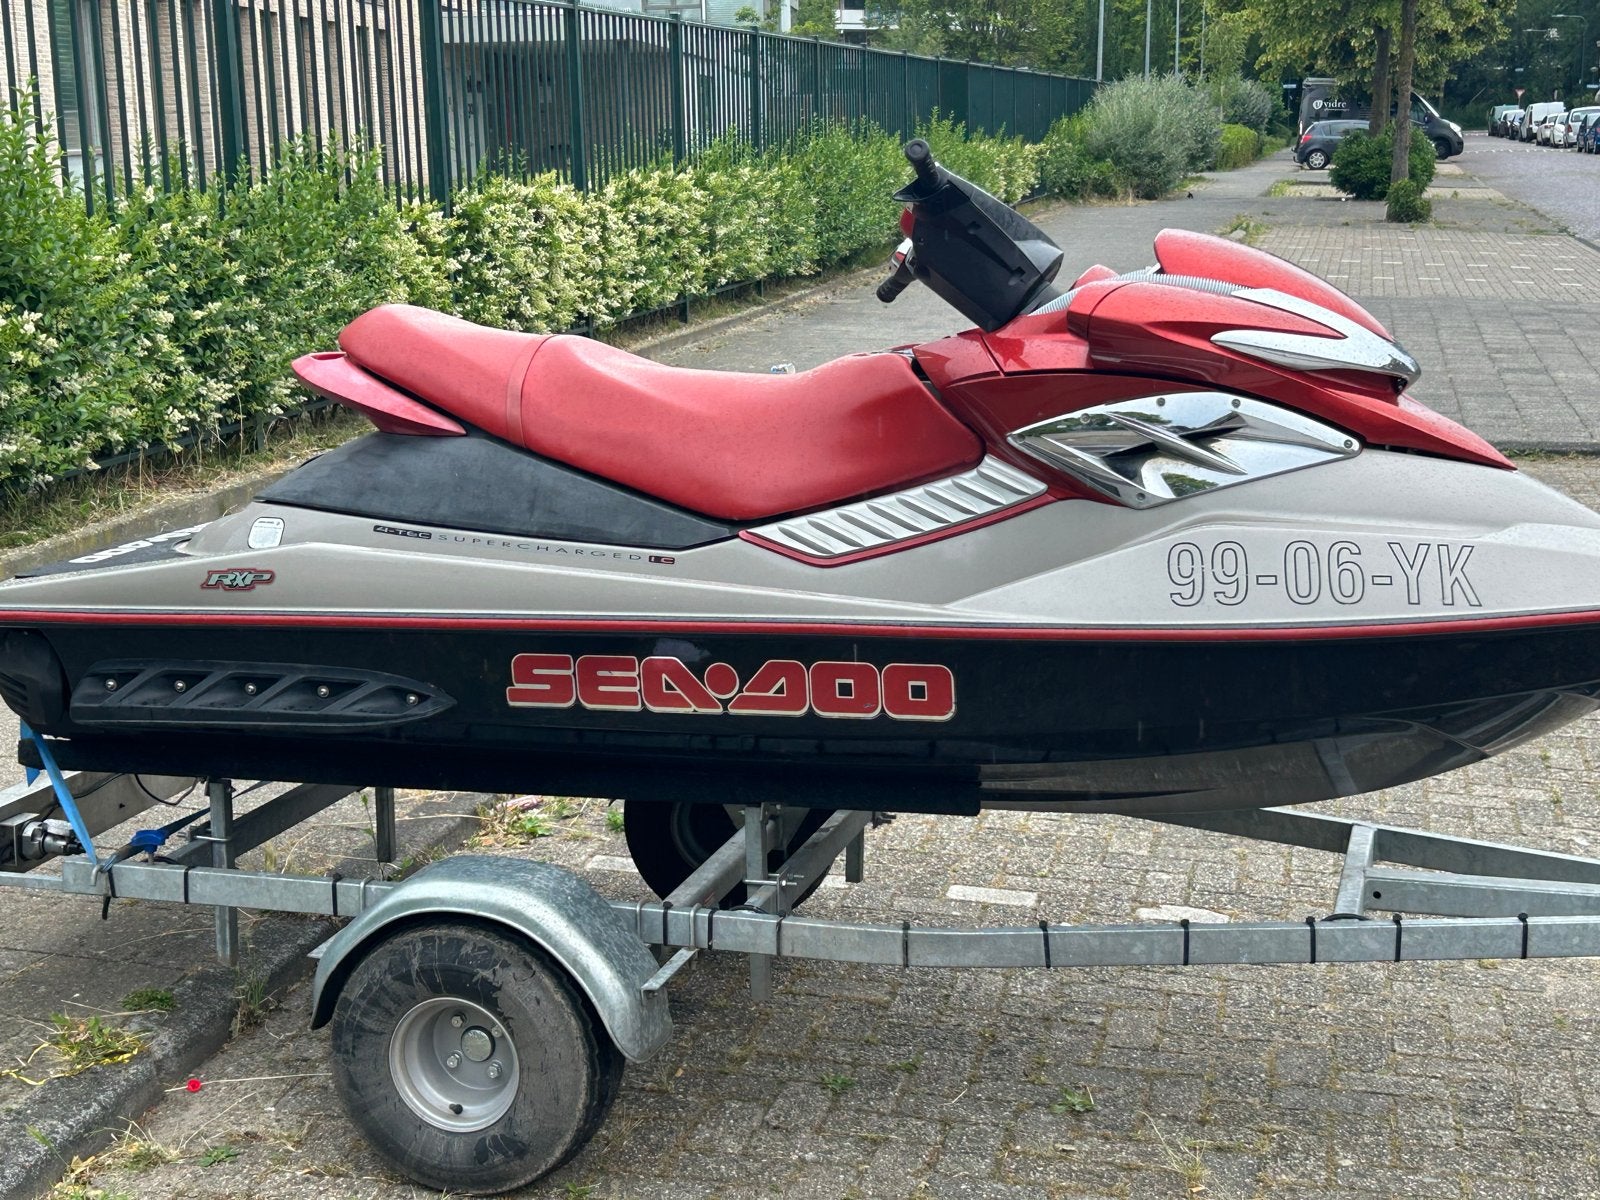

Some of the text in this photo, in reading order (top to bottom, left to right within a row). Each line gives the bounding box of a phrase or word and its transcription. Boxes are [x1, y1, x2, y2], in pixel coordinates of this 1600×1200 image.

[438, 534, 642, 561] SUPERCHARGED
[203, 569, 274, 590] RXP
[1167, 540, 1482, 607] 99-06-YK
